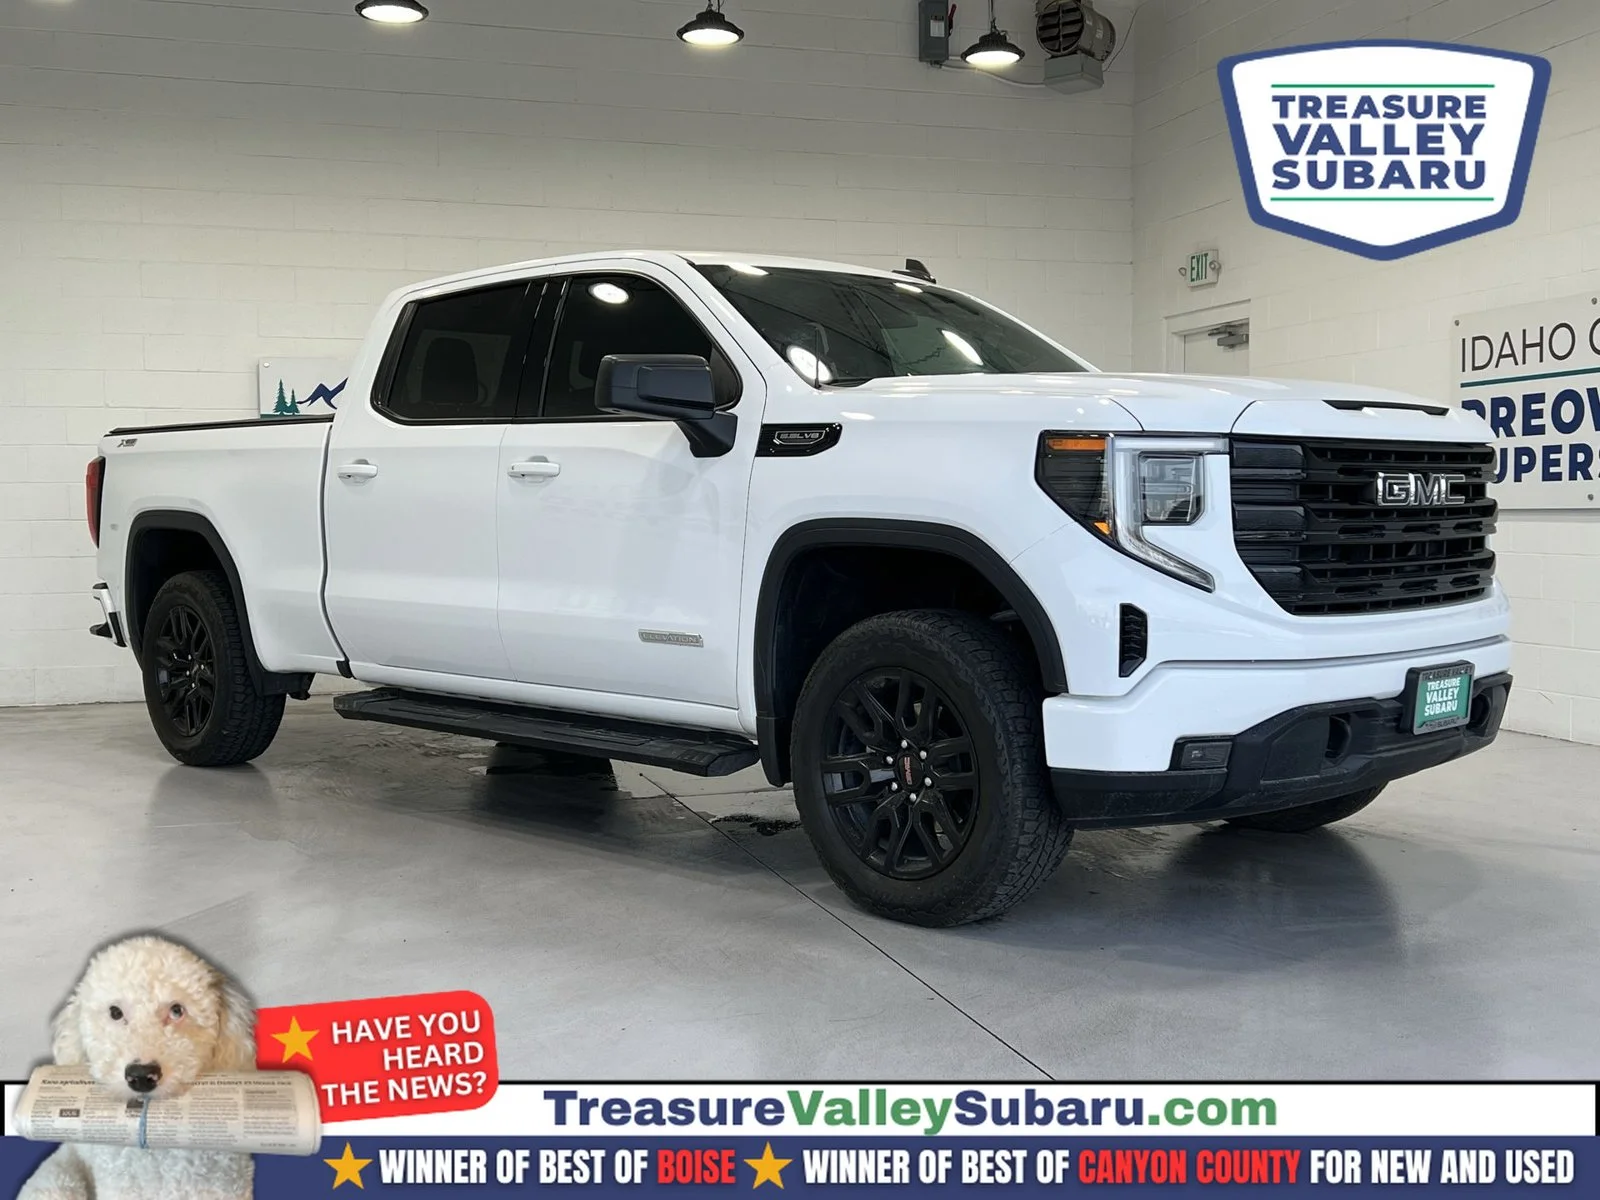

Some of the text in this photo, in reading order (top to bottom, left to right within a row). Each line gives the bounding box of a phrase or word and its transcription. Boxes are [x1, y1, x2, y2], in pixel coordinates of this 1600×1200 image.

[1191, 253, 1208, 282] EXIT
[1462, 323, 1576, 373] IDAHO
[1377, 472, 1465, 506] GMC
[1426, 687, 1460, 703] VALLEY
[1427, 677, 1461, 691] TREASURE
[1424, 700, 1458, 716] SUBARU
